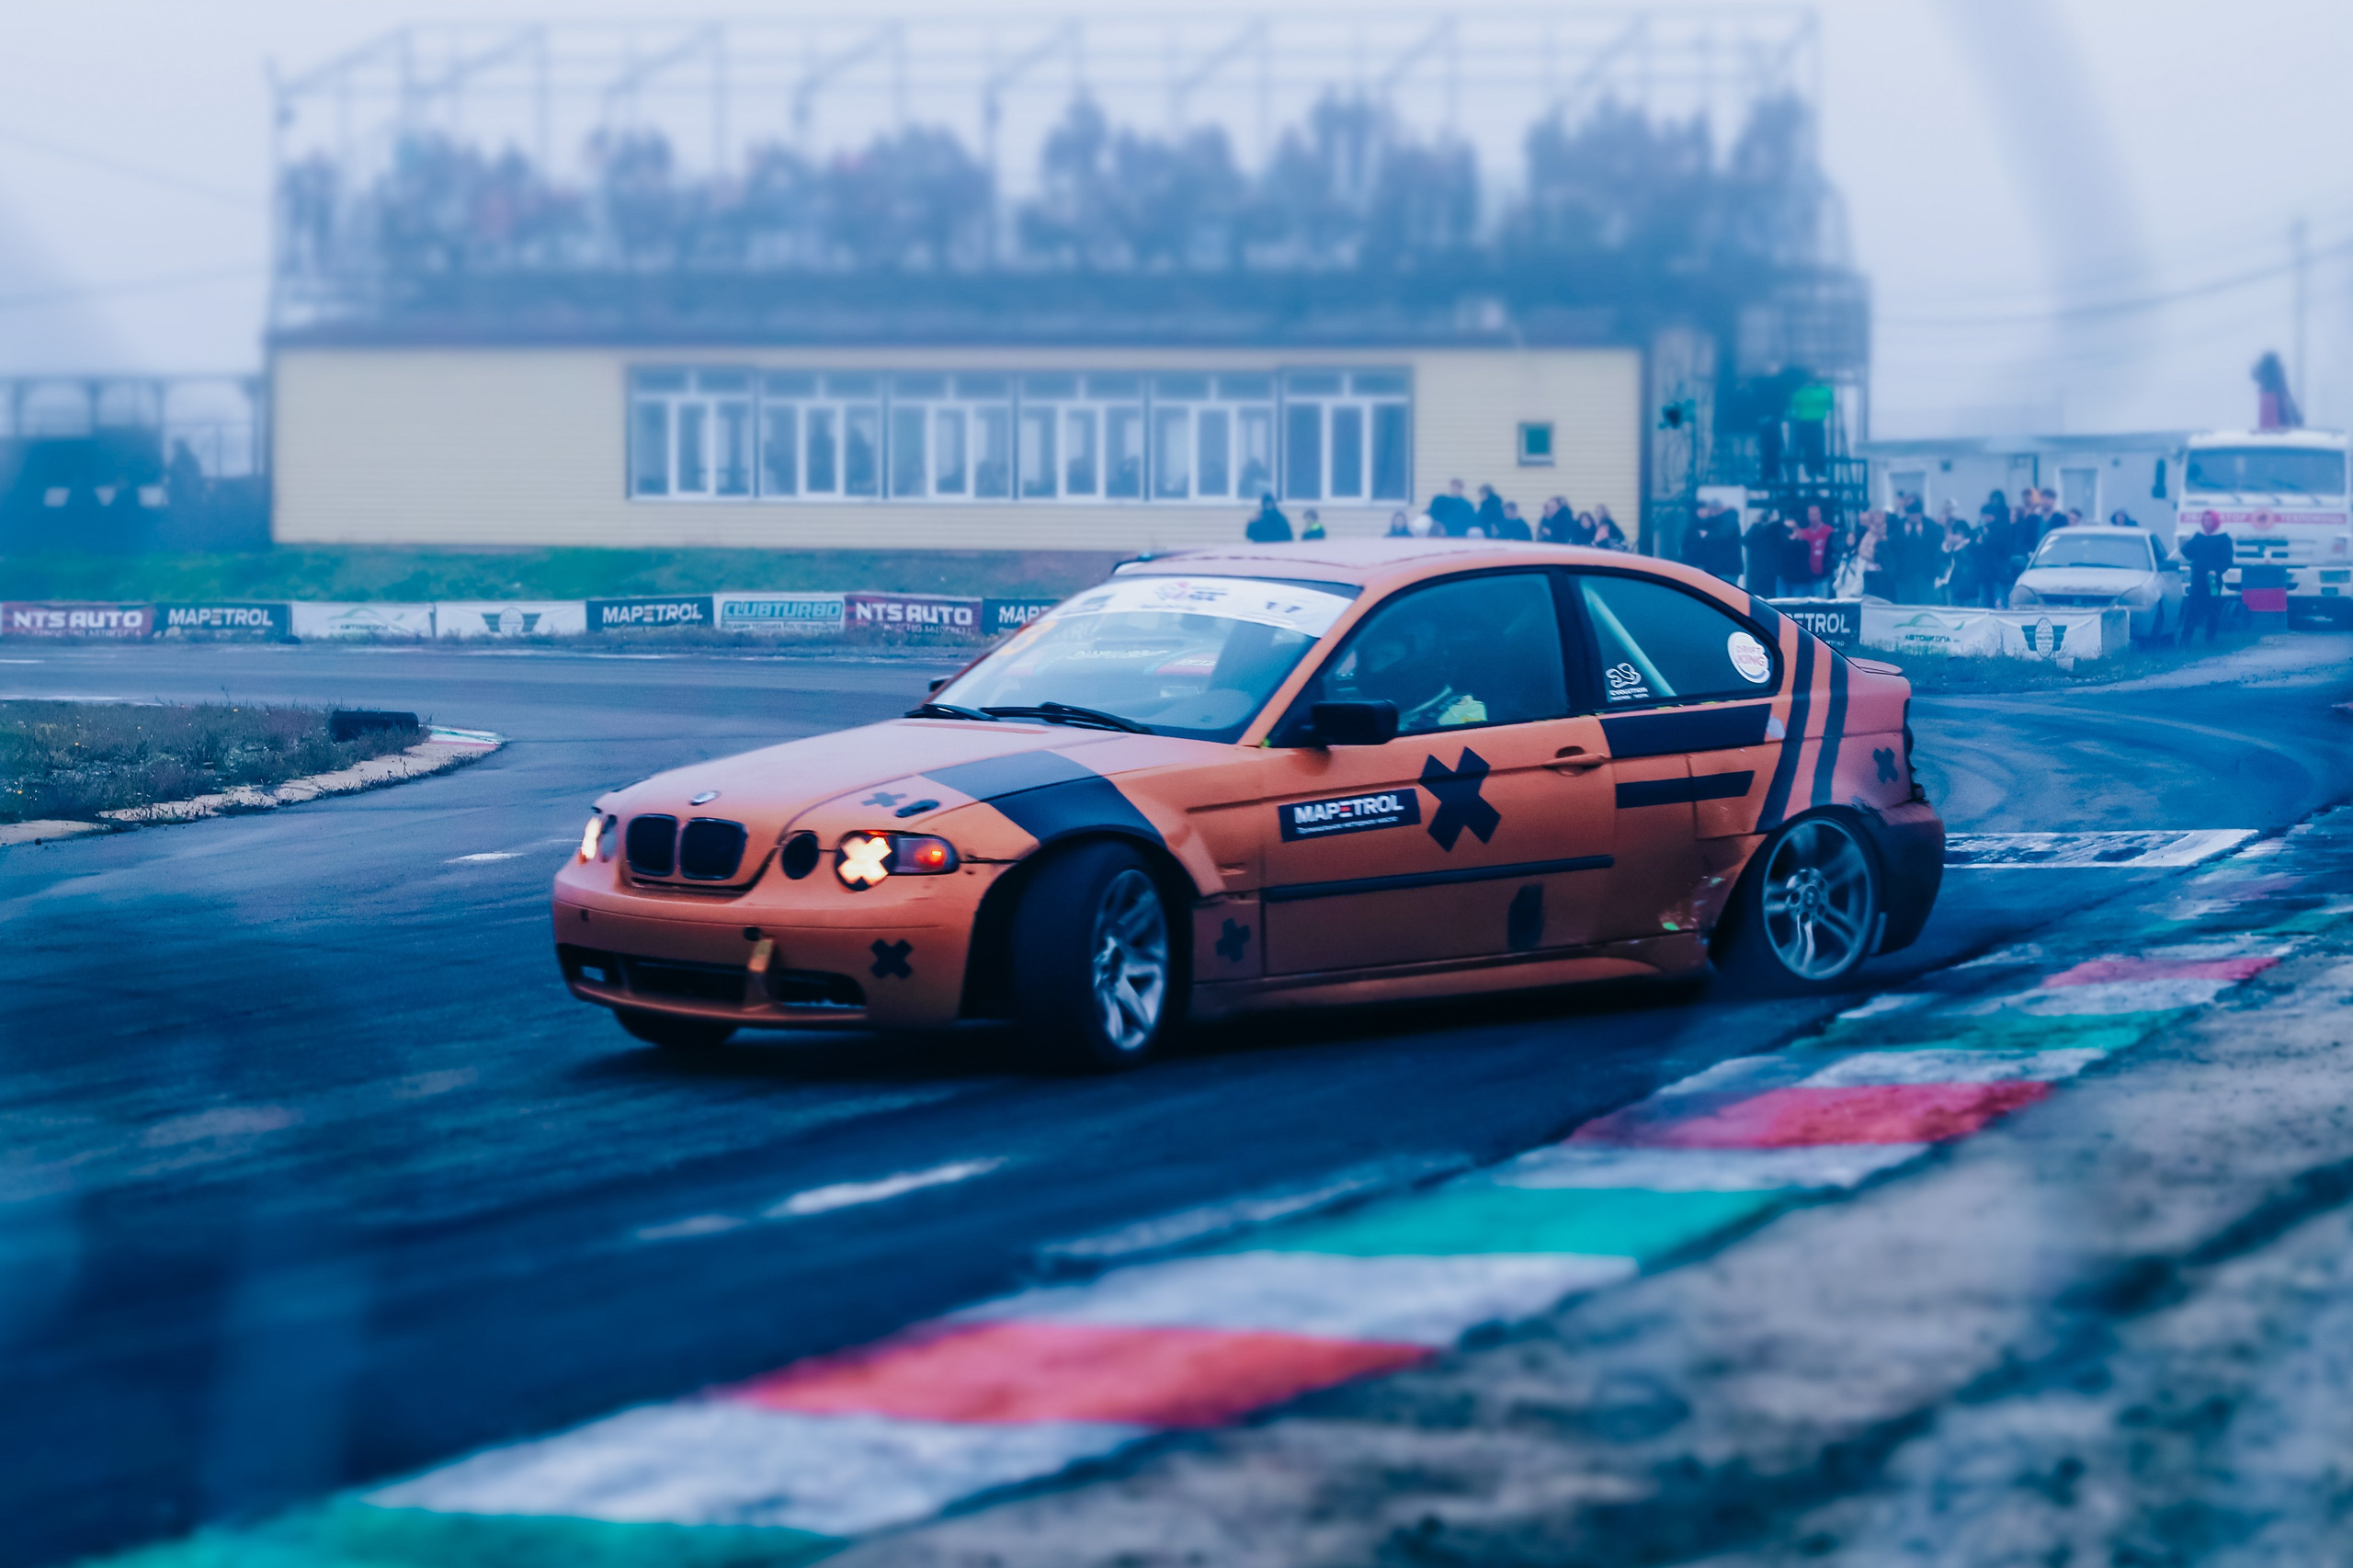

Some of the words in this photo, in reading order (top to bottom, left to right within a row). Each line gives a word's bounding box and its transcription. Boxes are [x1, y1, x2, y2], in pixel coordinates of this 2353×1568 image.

[2184, 514, 2248, 523] ЭВААТОР
[13, 610, 66, 628] NTS
[69, 610, 143, 628] AUTO
[168, 608, 273, 627] MAPETROL
[602, 603, 703, 624] MAPETROL
[722, 601, 843, 621] CLUBTURBO
[856, 602, 903, 621] NTS
[906, 604, 972, 626] AUTO
[1294, 794, 1404, 824] MAPETROL
